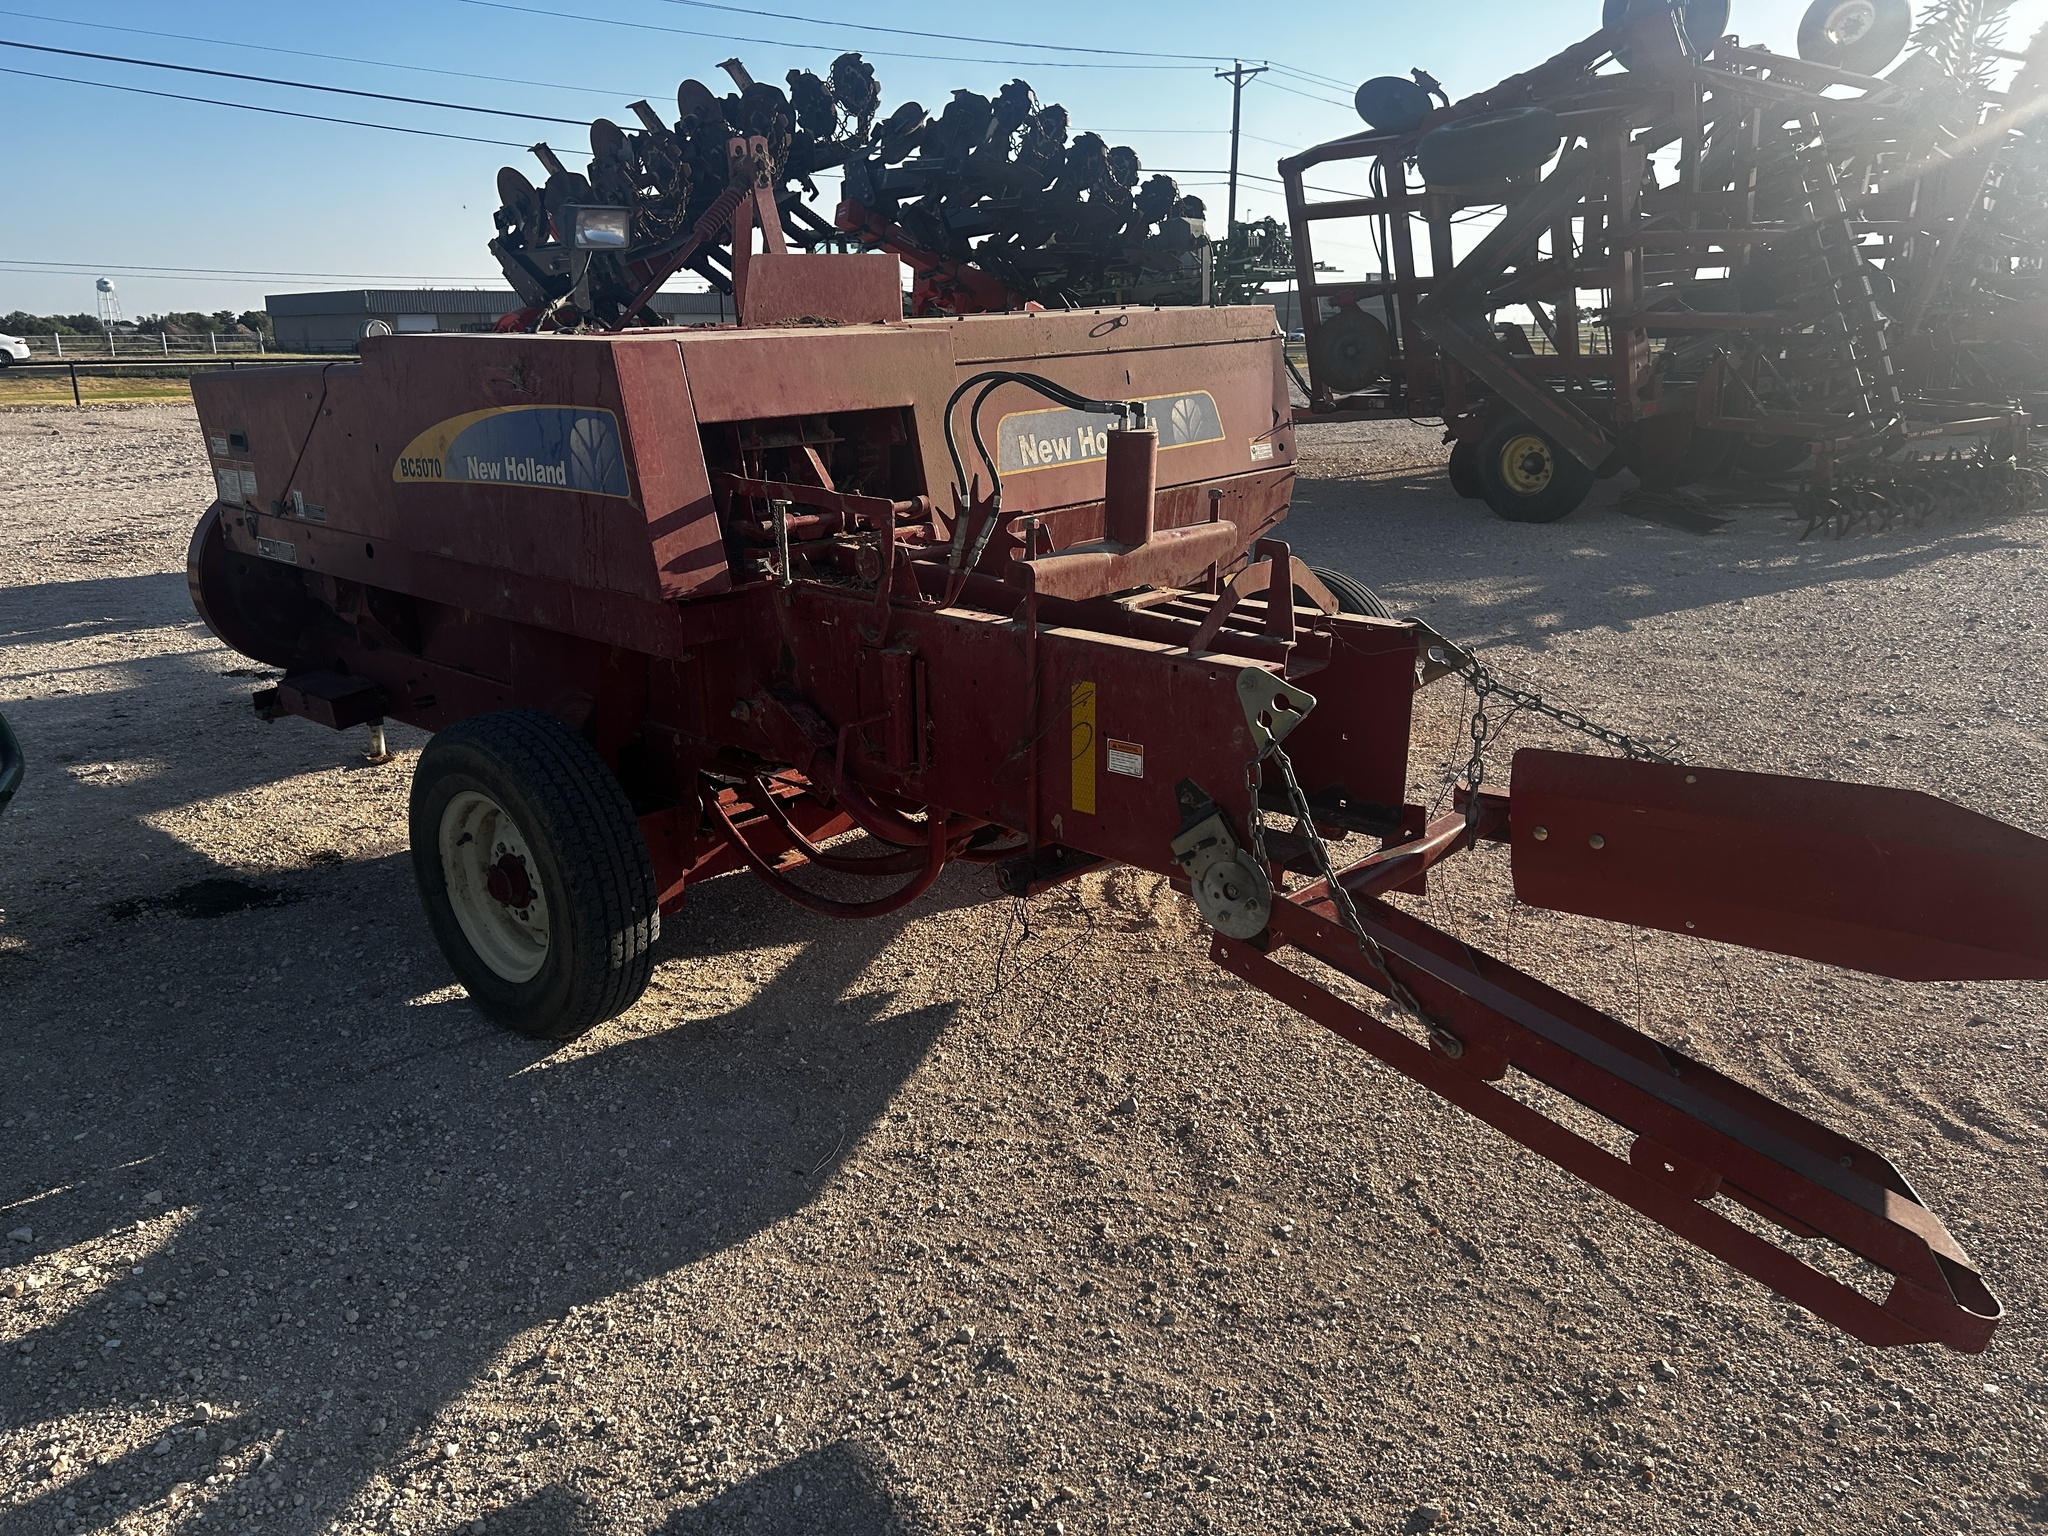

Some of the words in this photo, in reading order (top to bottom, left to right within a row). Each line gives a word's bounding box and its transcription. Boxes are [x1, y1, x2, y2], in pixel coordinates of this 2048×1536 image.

[1018, 433, 1071, 466] New
[400, 457, 442, 478] BC5070
[466, 456, 500, 480] New
[504, 456, 567, 486] Holland
